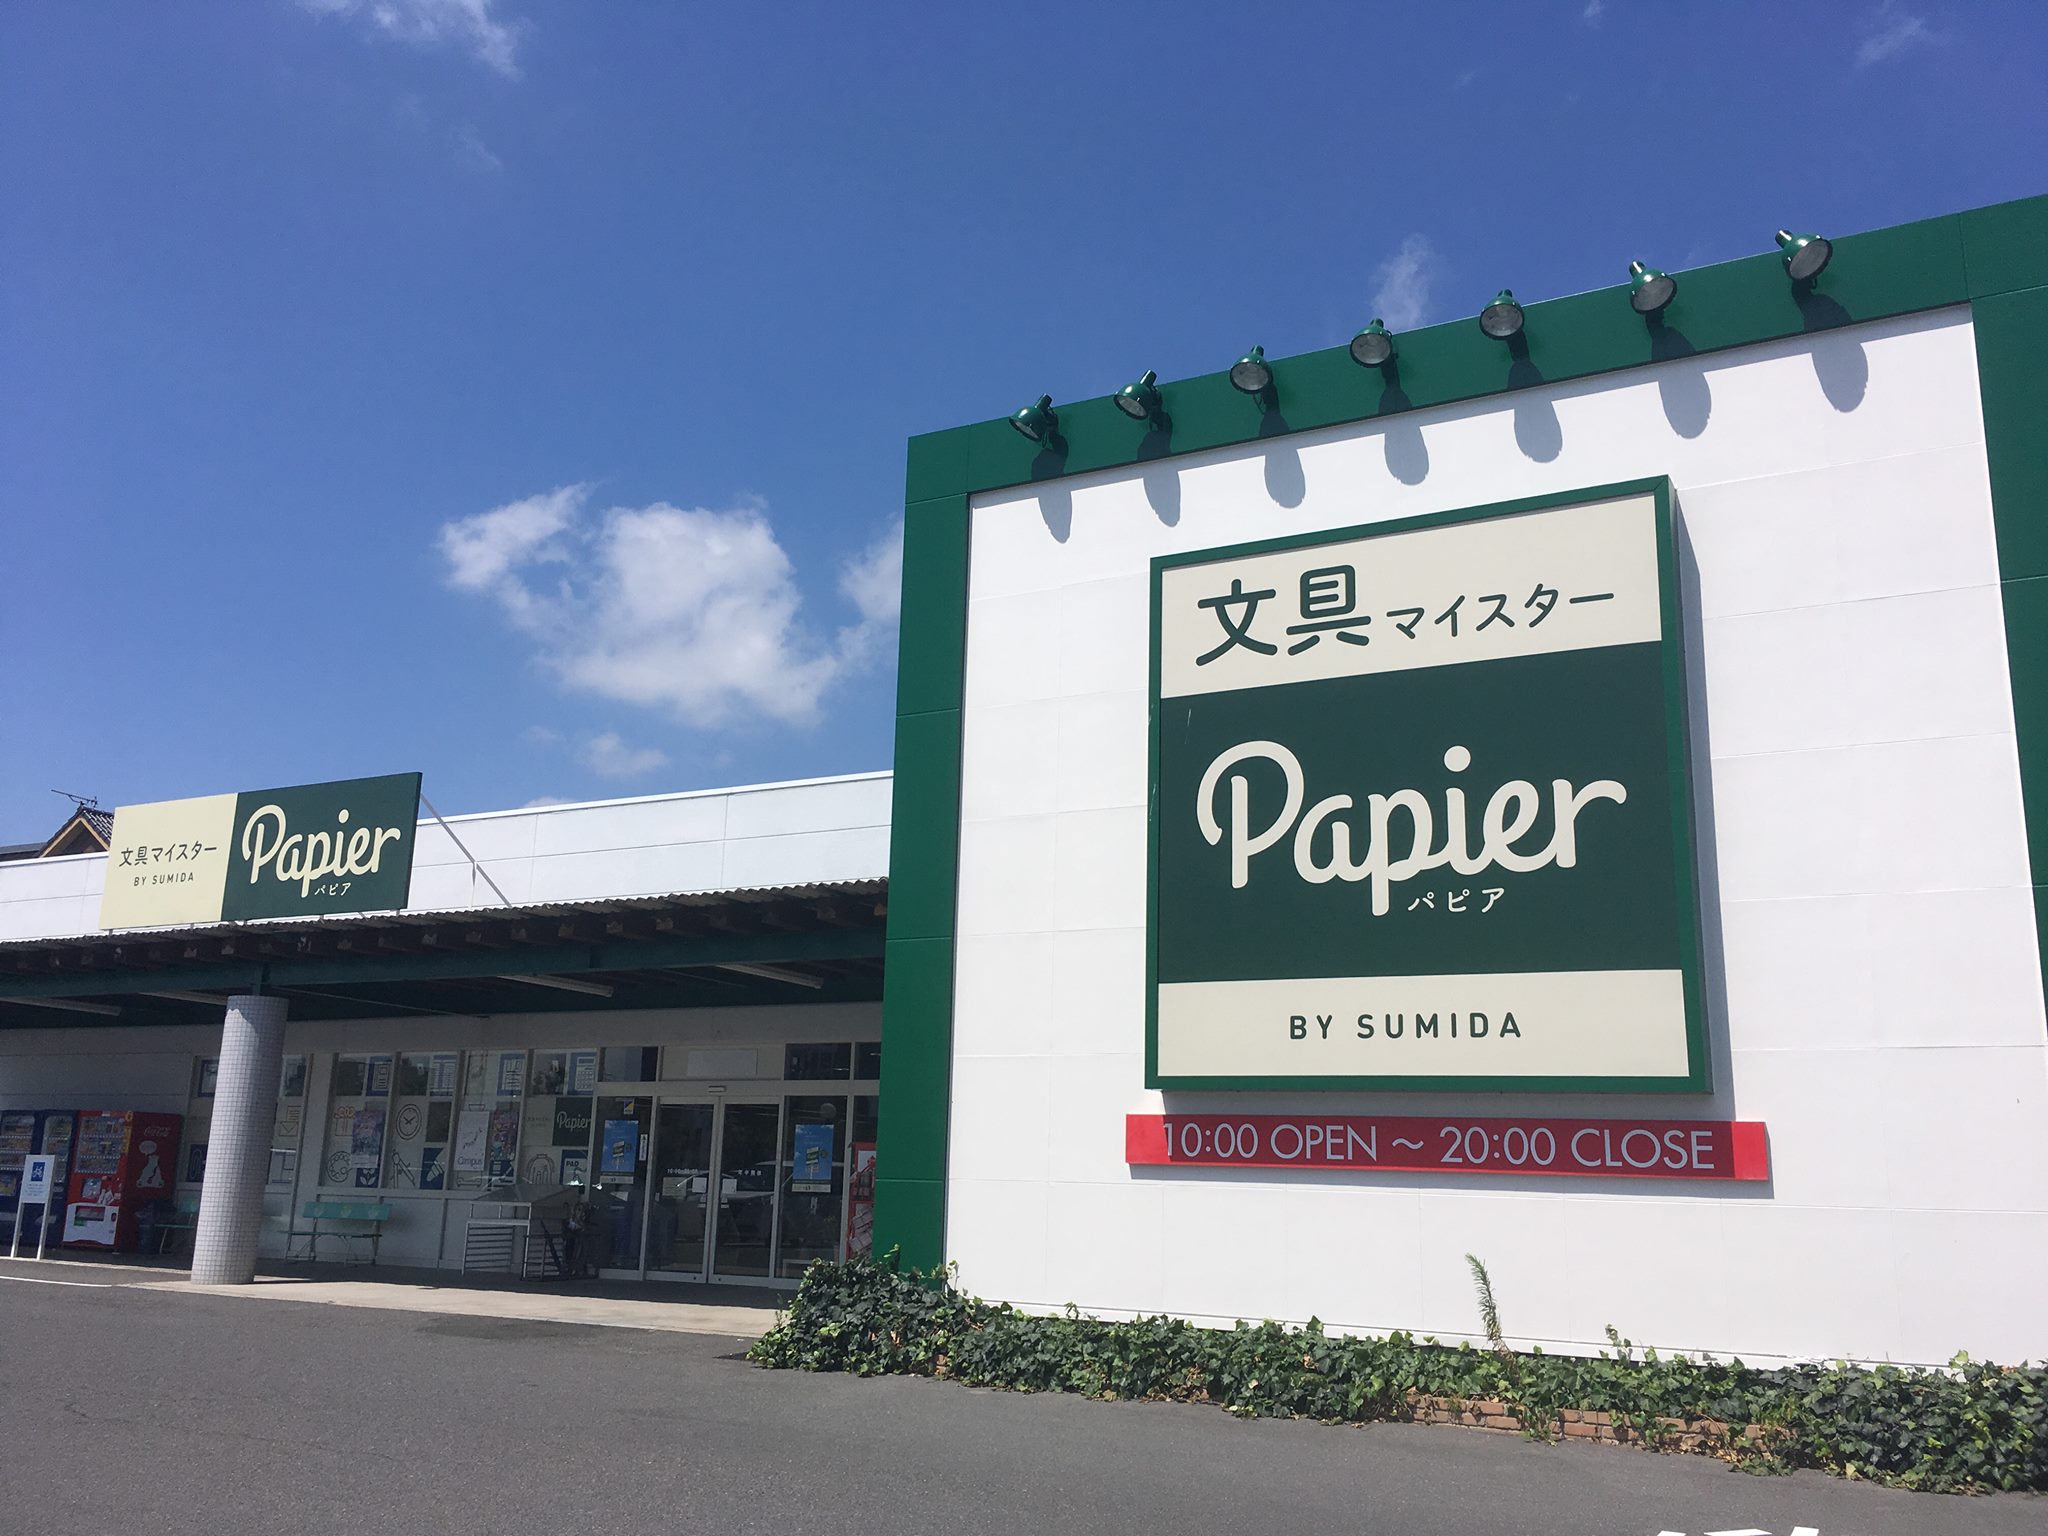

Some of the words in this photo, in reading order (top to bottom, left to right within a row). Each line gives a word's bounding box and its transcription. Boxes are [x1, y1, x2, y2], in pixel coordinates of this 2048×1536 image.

[1196, 564, 1615, 667] 文具マイスター
[1196, 740, 1627, 917] Papier
[118, 840, 218, 868] 文具マイスター
[241, 804, 401, 898] Papier
[133, 876, 148, 887] BY
[151, 871, 194, 885] SUMIDA
[314, 881, 352, 896] パピア
[1407, 886, 1506, 913] パピア
[1289, 1014, 1333, 1040] BY
[1356, 1011, 1522, 1040] SUMIDA
[556, 1110, 592, 1133] Papier
[1164, 1122, 1259, 1158] 10:00
[1270, 1123, 1377, 1162] OPEN
[1439, 1126, 1556, 1166] 20:00
[1571, 1128, 1715, 1169] CLOSE
